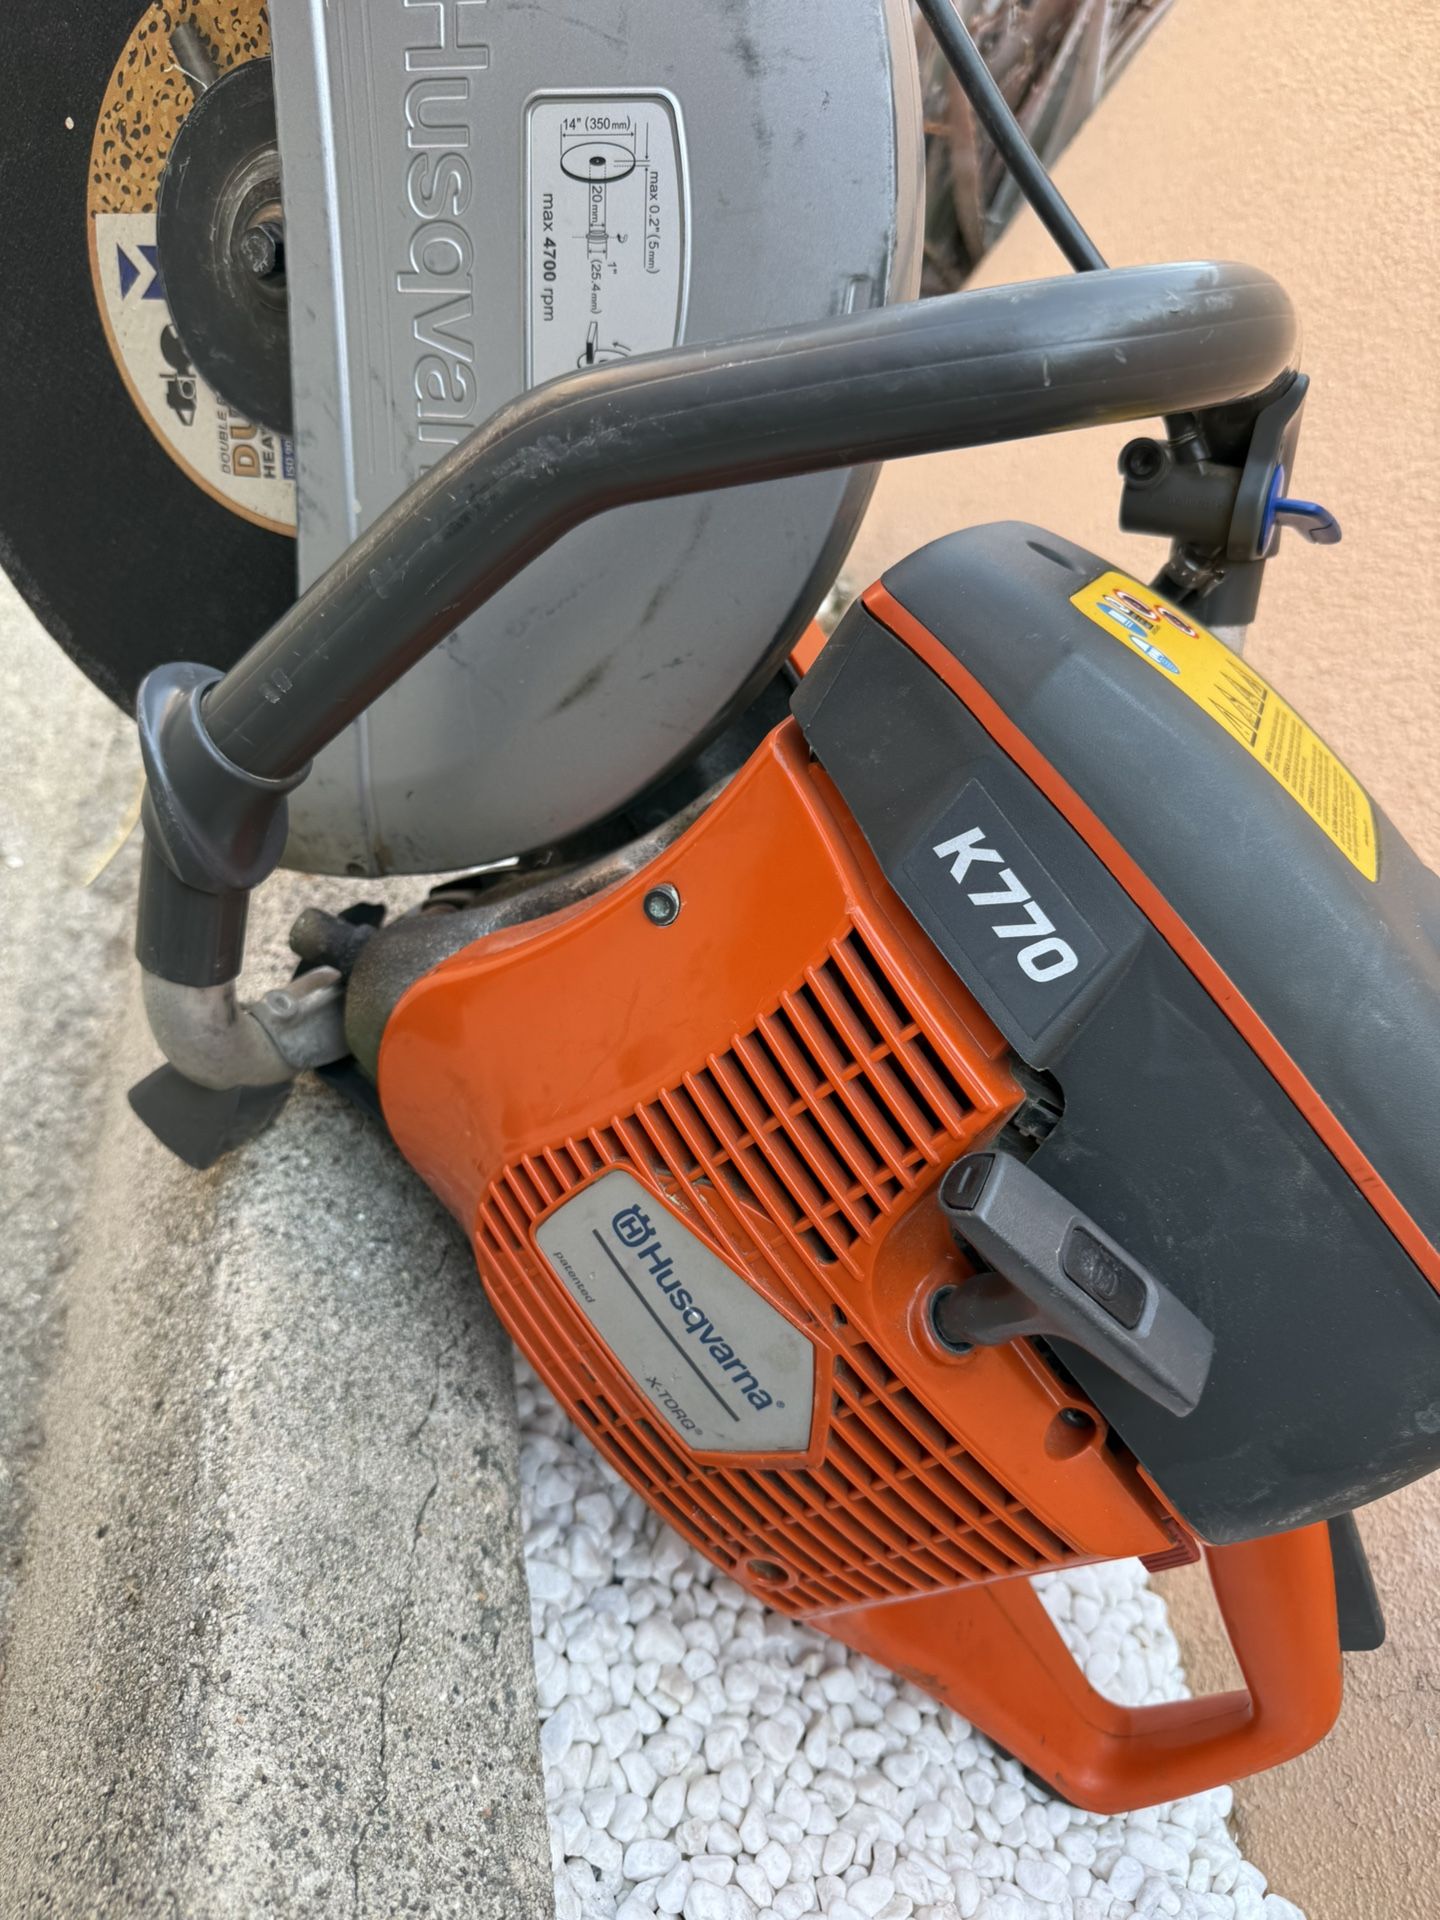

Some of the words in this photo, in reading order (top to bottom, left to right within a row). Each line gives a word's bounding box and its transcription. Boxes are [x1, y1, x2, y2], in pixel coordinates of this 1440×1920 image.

[563, 117, 581, 130] 14"
[649, 171, 659, 201] max
[543, 193, 554, 231] max
[397, 0, 489, 474] Husqvar
[543, 237, 557, 282] 4700
[541, 288, 554, 322] rpm
[217, 410, 231, 474] DOUBLE
[932, 826, 1079, 983] K770
[553, 1251, 596, 1305] patented
